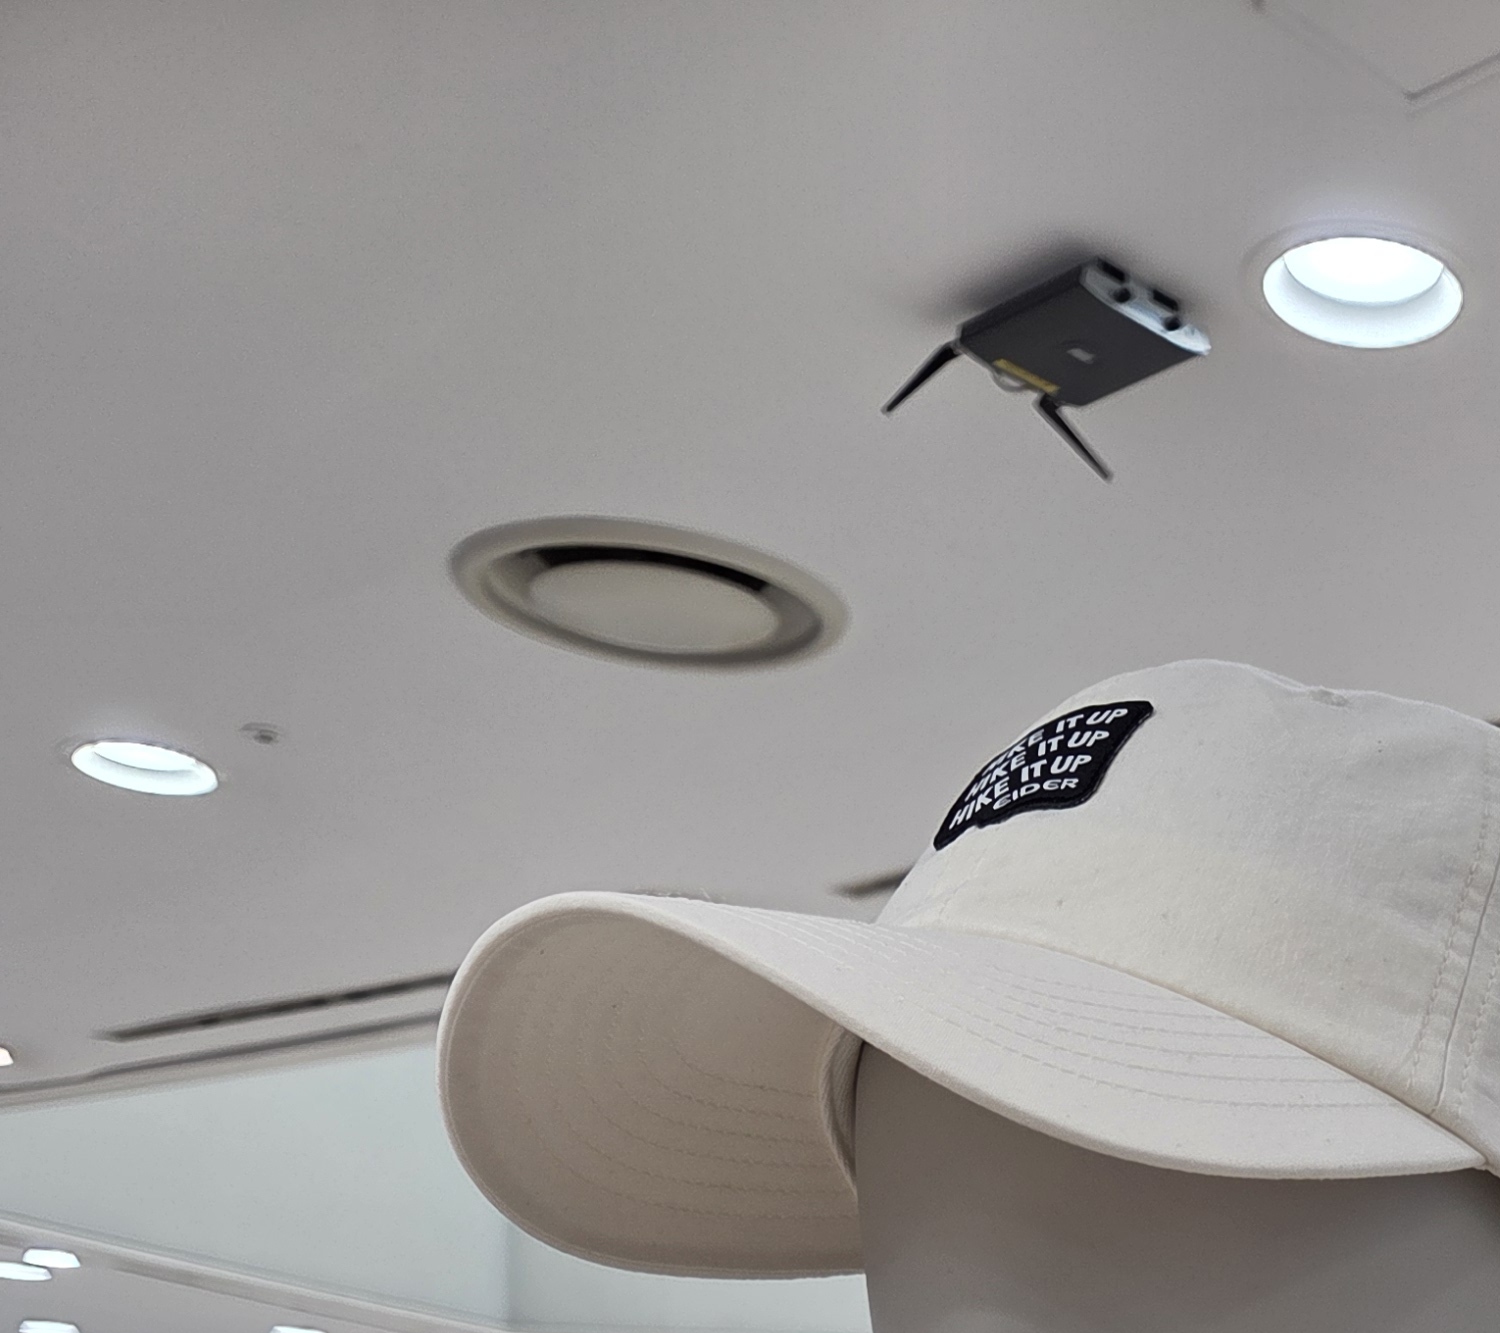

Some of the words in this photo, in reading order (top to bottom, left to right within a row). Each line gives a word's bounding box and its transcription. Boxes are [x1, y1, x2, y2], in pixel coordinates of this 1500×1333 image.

[1056, 714, 1084, 734] IT
[1086, 708, 1128, 725] UP
[949, 776, 1009, 830] HIKE
[1021, 759, 1047, 783] IT
[1050, 754, 1092, 774] UP
[964, 751, 1026, 802] HIKE
[1037, 735, 1064, 757] IT
[1067, 730, 1109, 749] UP
[992, 778, 1079, 811] EIDER
